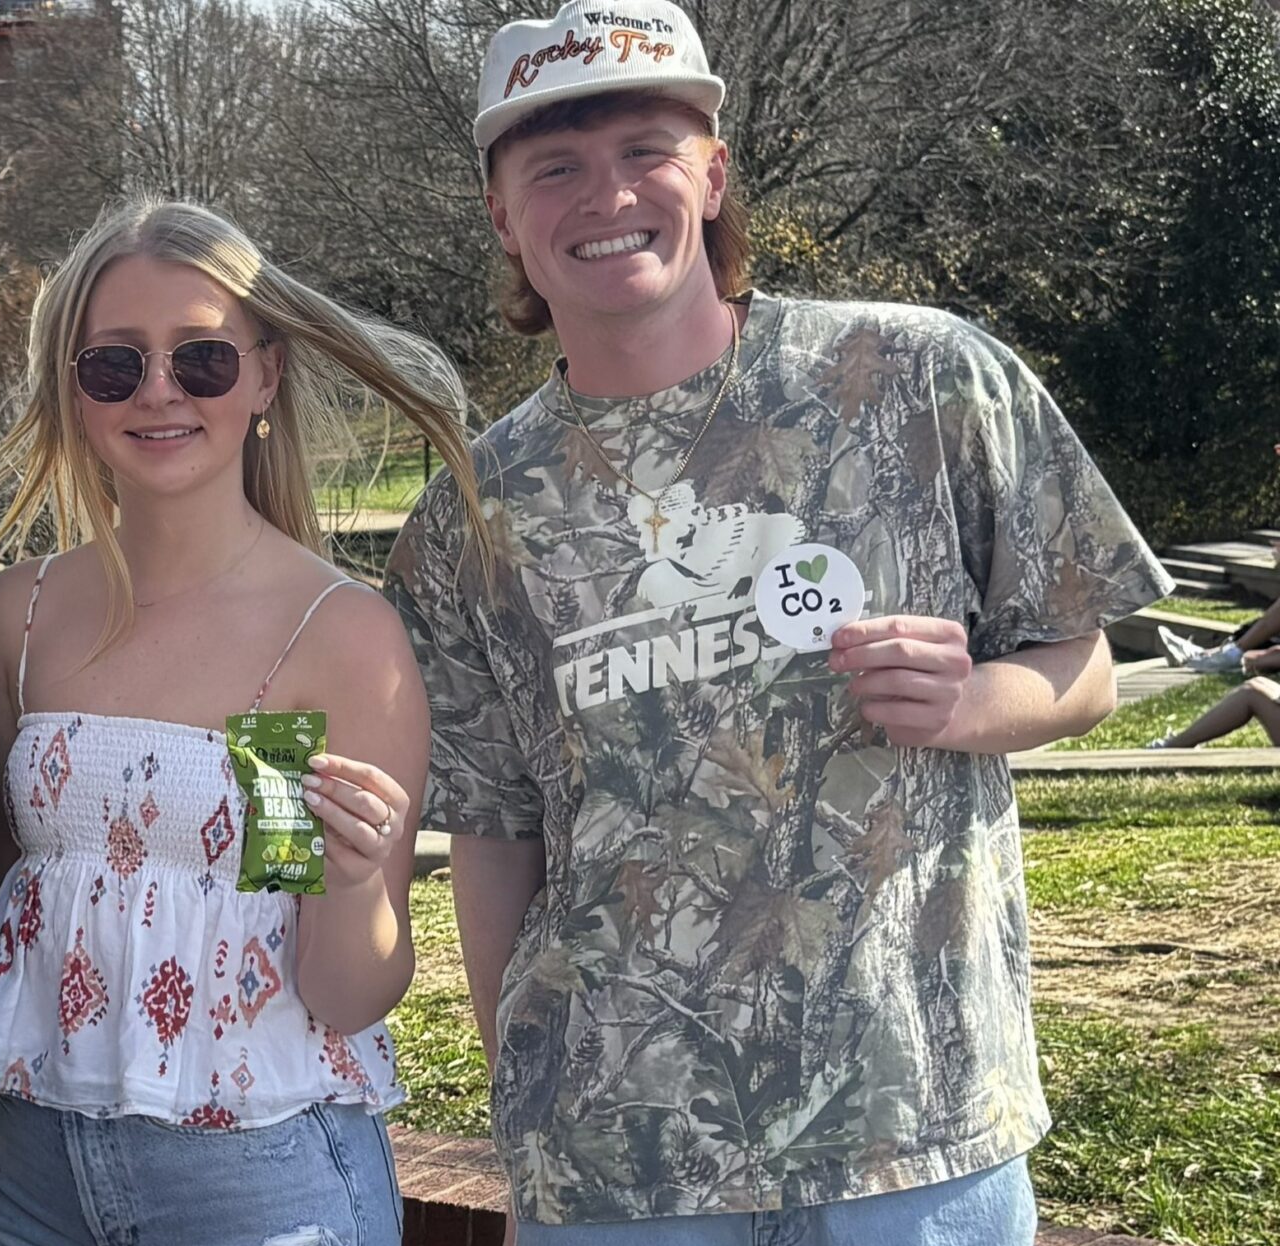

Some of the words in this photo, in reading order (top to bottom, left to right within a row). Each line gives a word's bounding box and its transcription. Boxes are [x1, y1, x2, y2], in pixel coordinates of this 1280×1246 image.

[584, 12, 651, 30] Welcome
[652, 19, 673, 32] To
[504, 30, 603, 98] Rocky
[775, 564, 795, 588] I
